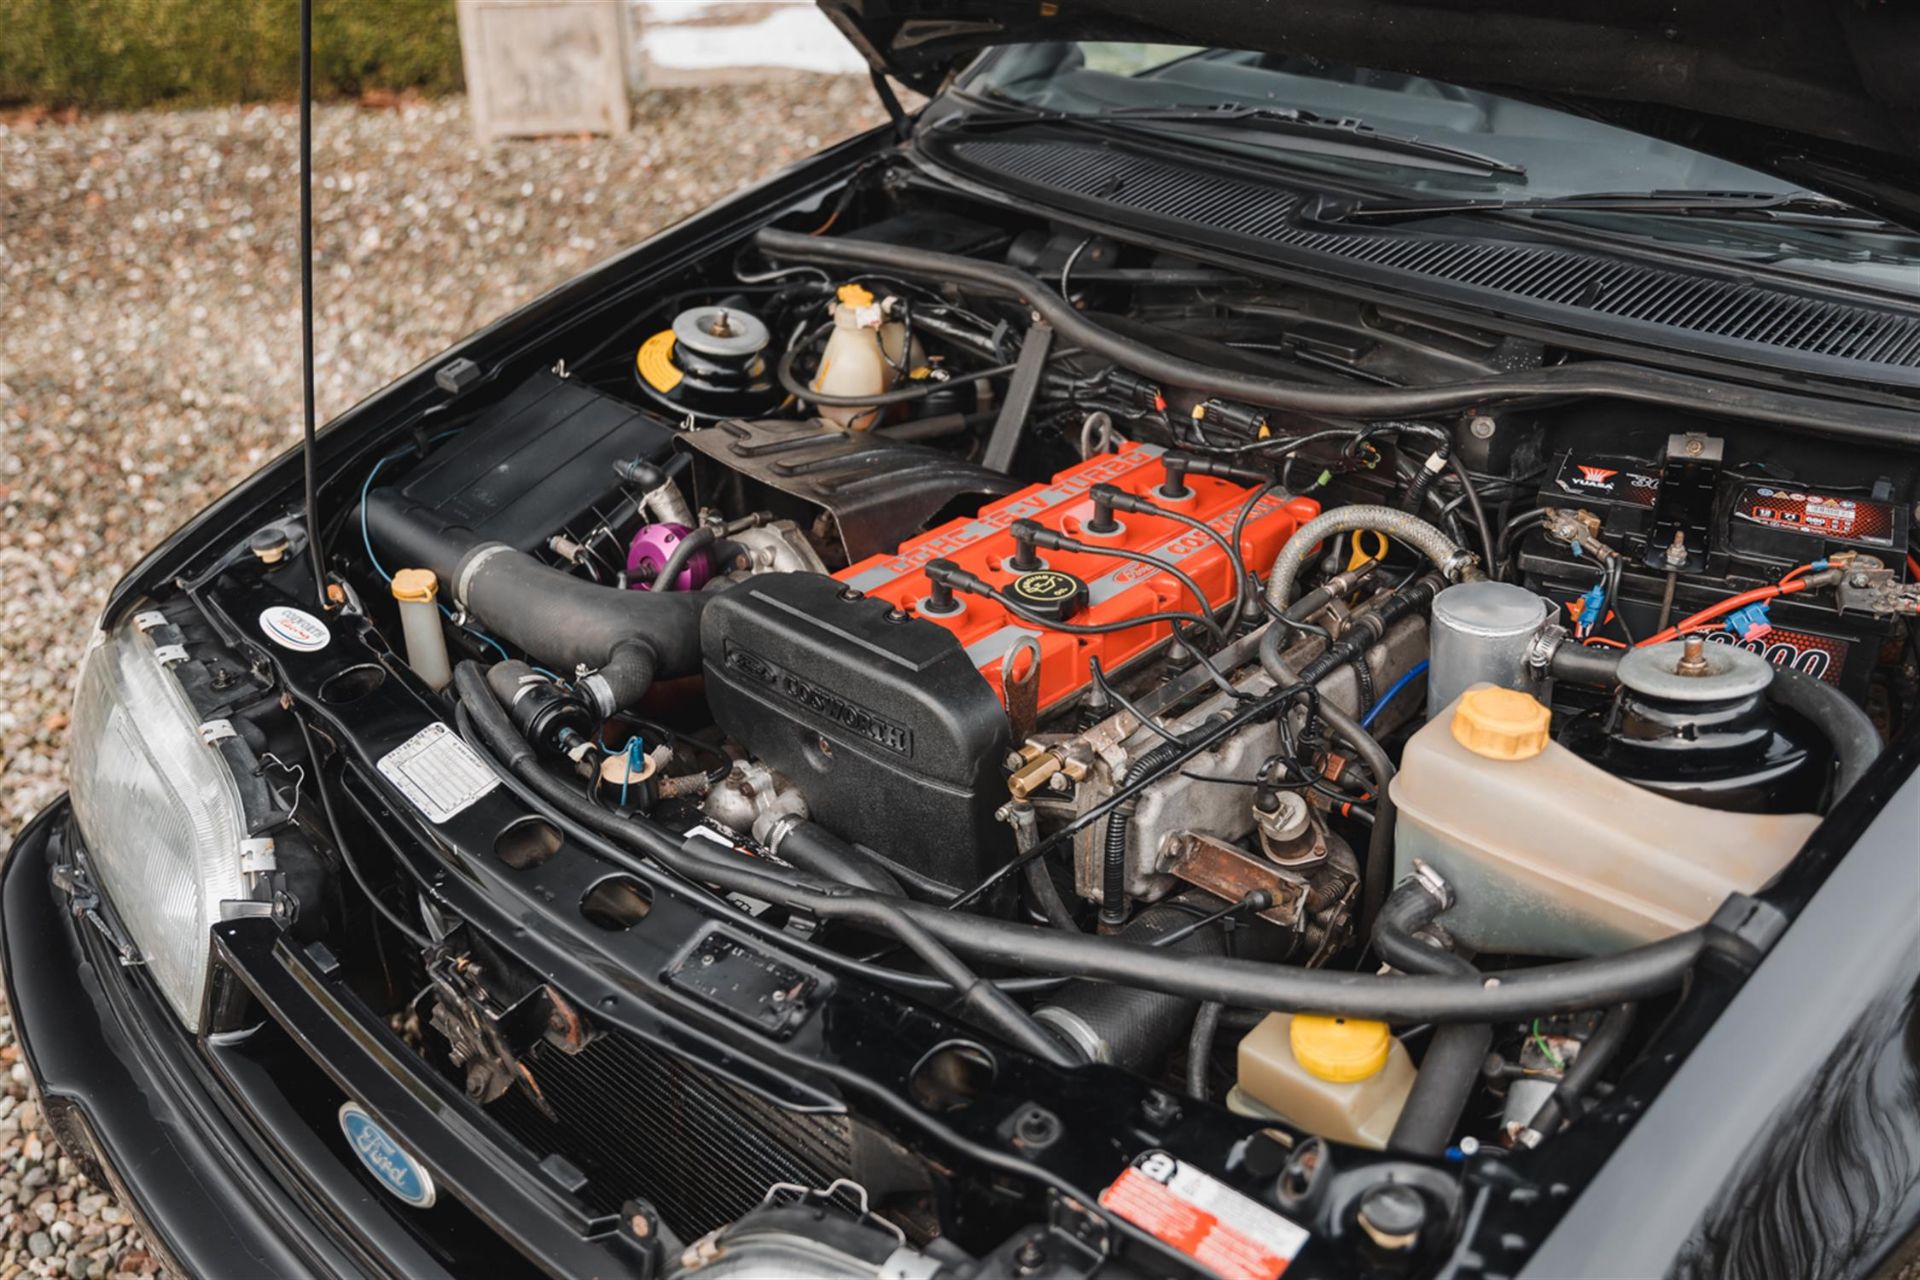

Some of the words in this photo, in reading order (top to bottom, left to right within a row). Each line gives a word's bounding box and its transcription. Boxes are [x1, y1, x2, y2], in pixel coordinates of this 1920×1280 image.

[888, 526, 981, 573] DOHC
[1050, 450, 1150, 496] TURBO
[1572, 478, 1614, 490] YUASA
[783, 673, 906, 751] COSWORTH
[356, 1126, 409, 1185] Ford
